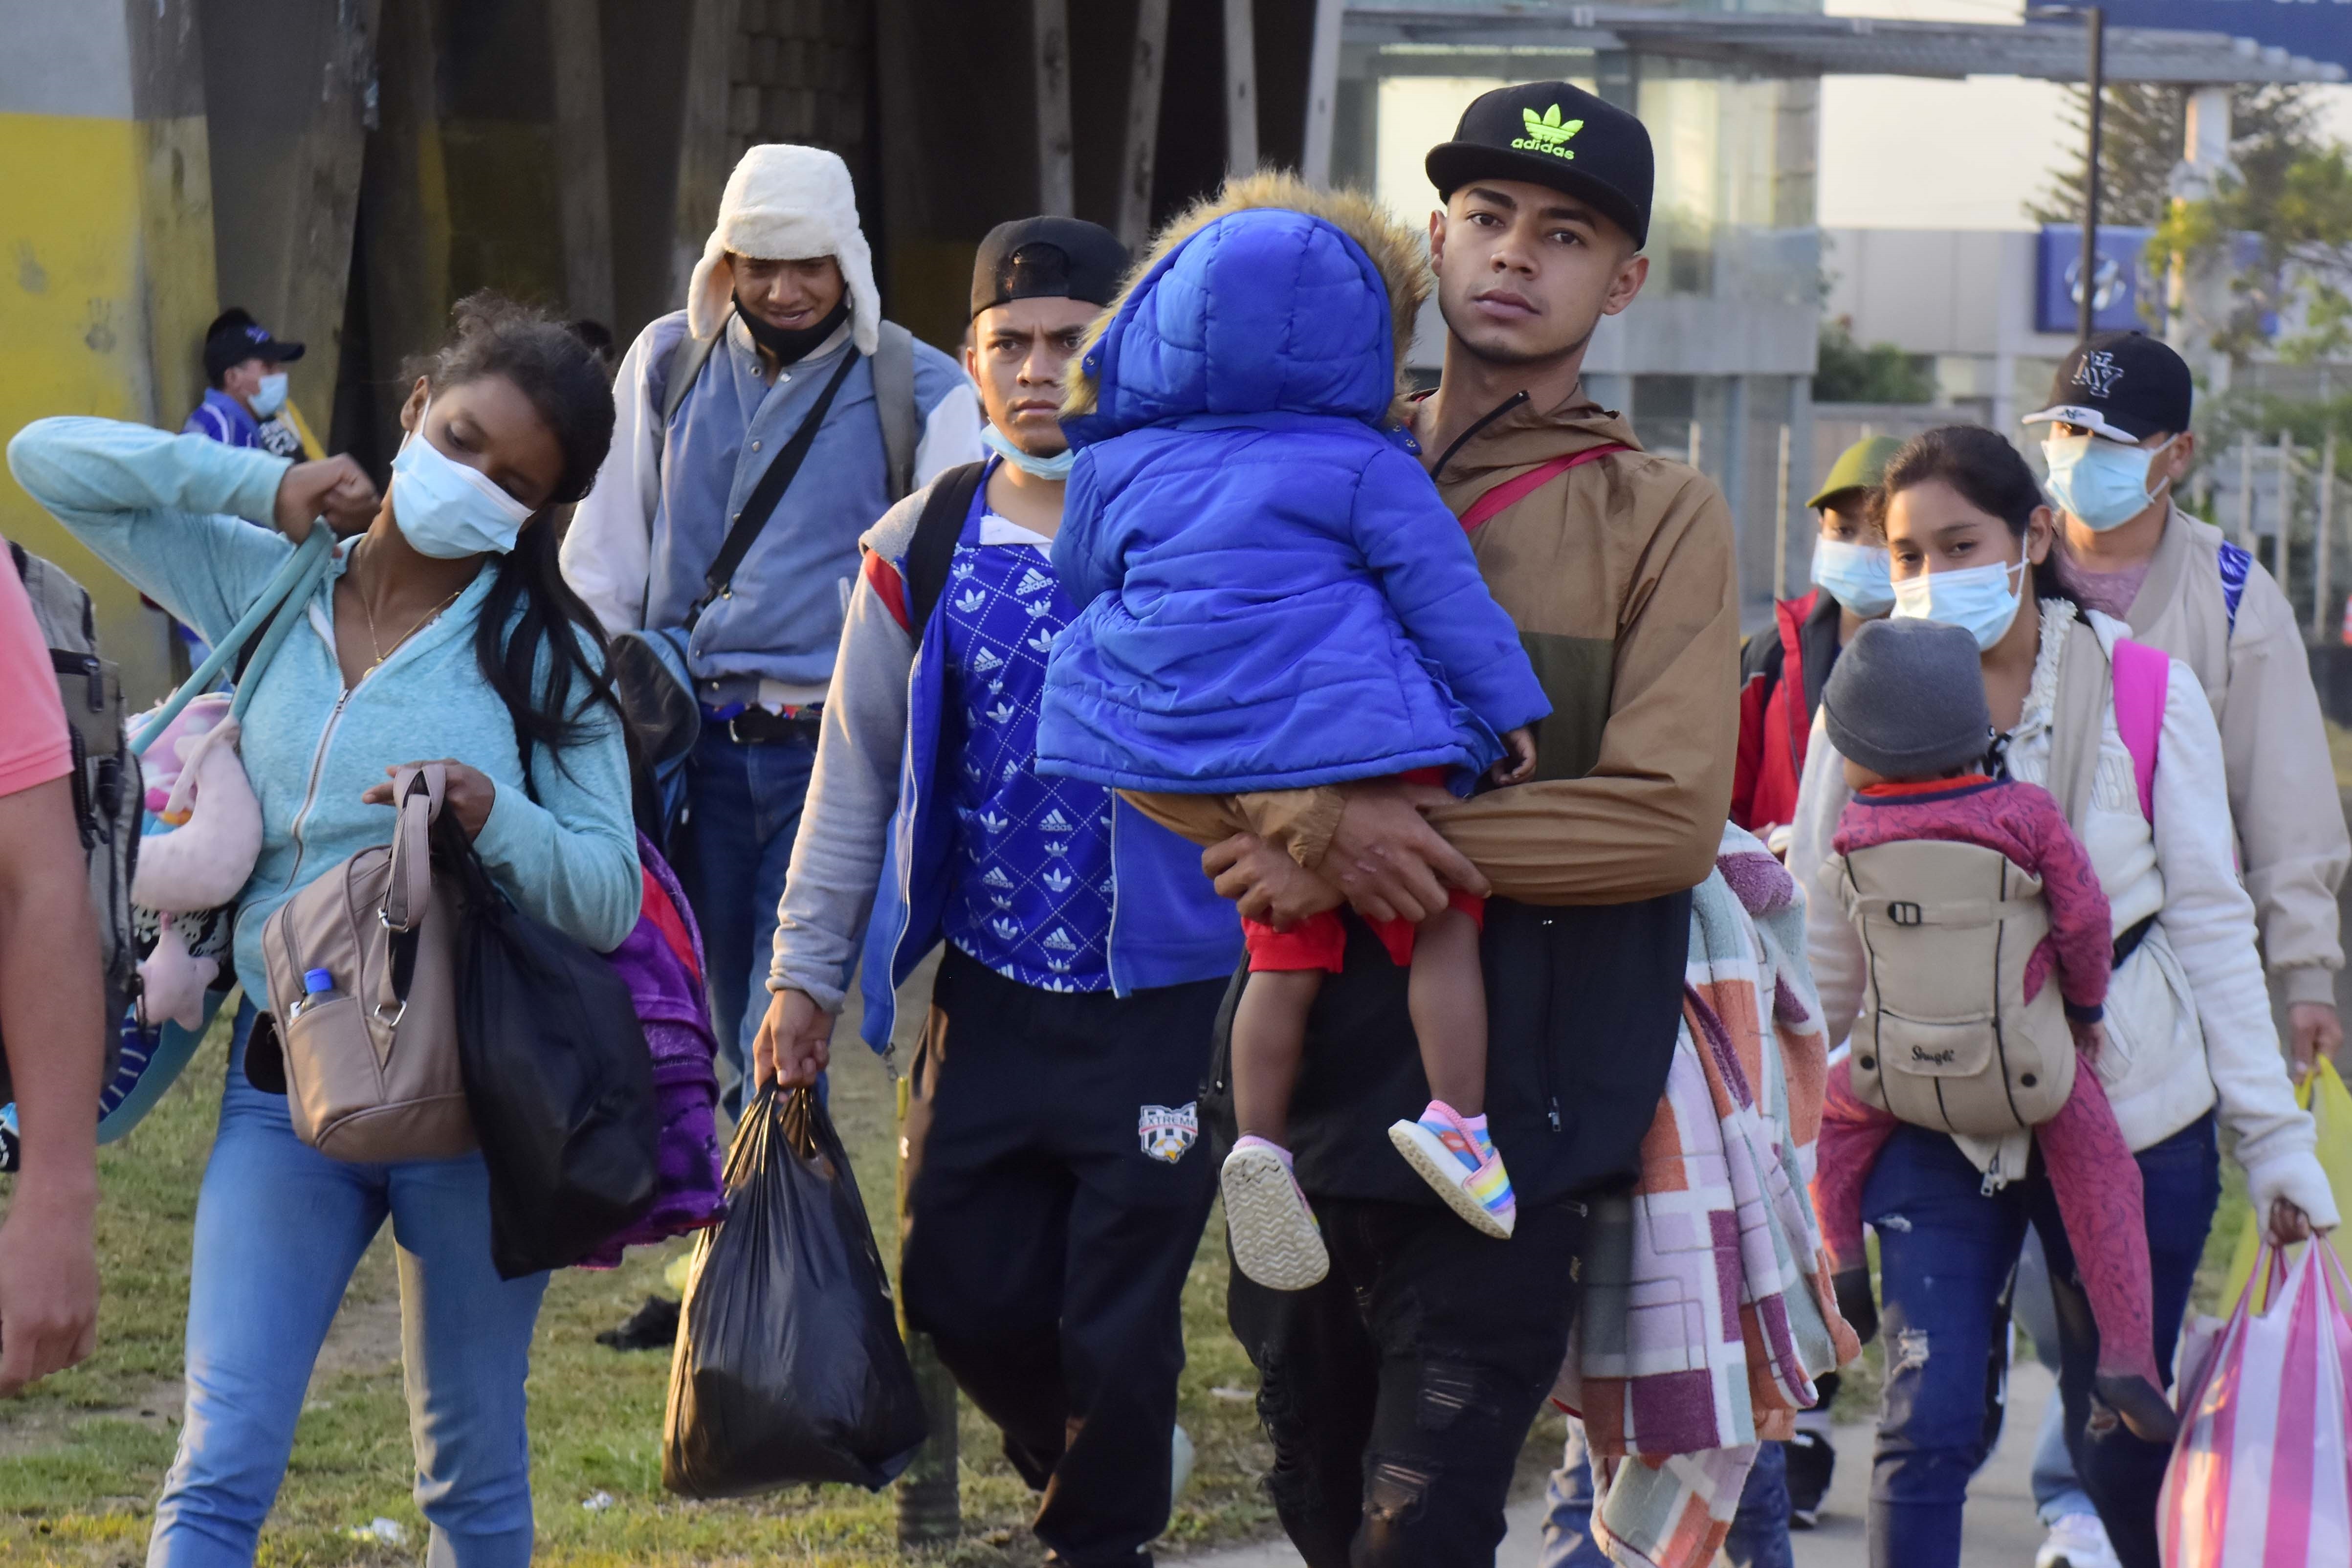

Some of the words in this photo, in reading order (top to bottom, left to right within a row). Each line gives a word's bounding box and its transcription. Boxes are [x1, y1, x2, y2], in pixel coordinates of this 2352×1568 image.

[1510, 137, 1575, 160] adidas
[1015, 577, 1054, 596] adidas
[974, 658, 1004, 672] adidas
[1038, 823, 1073, 832] adidas
[982, 878, 1014, 889] adidas
[1043, 941, 1077, 951] adidas
[1139, 1116, 1196, 1126] EXTREME
